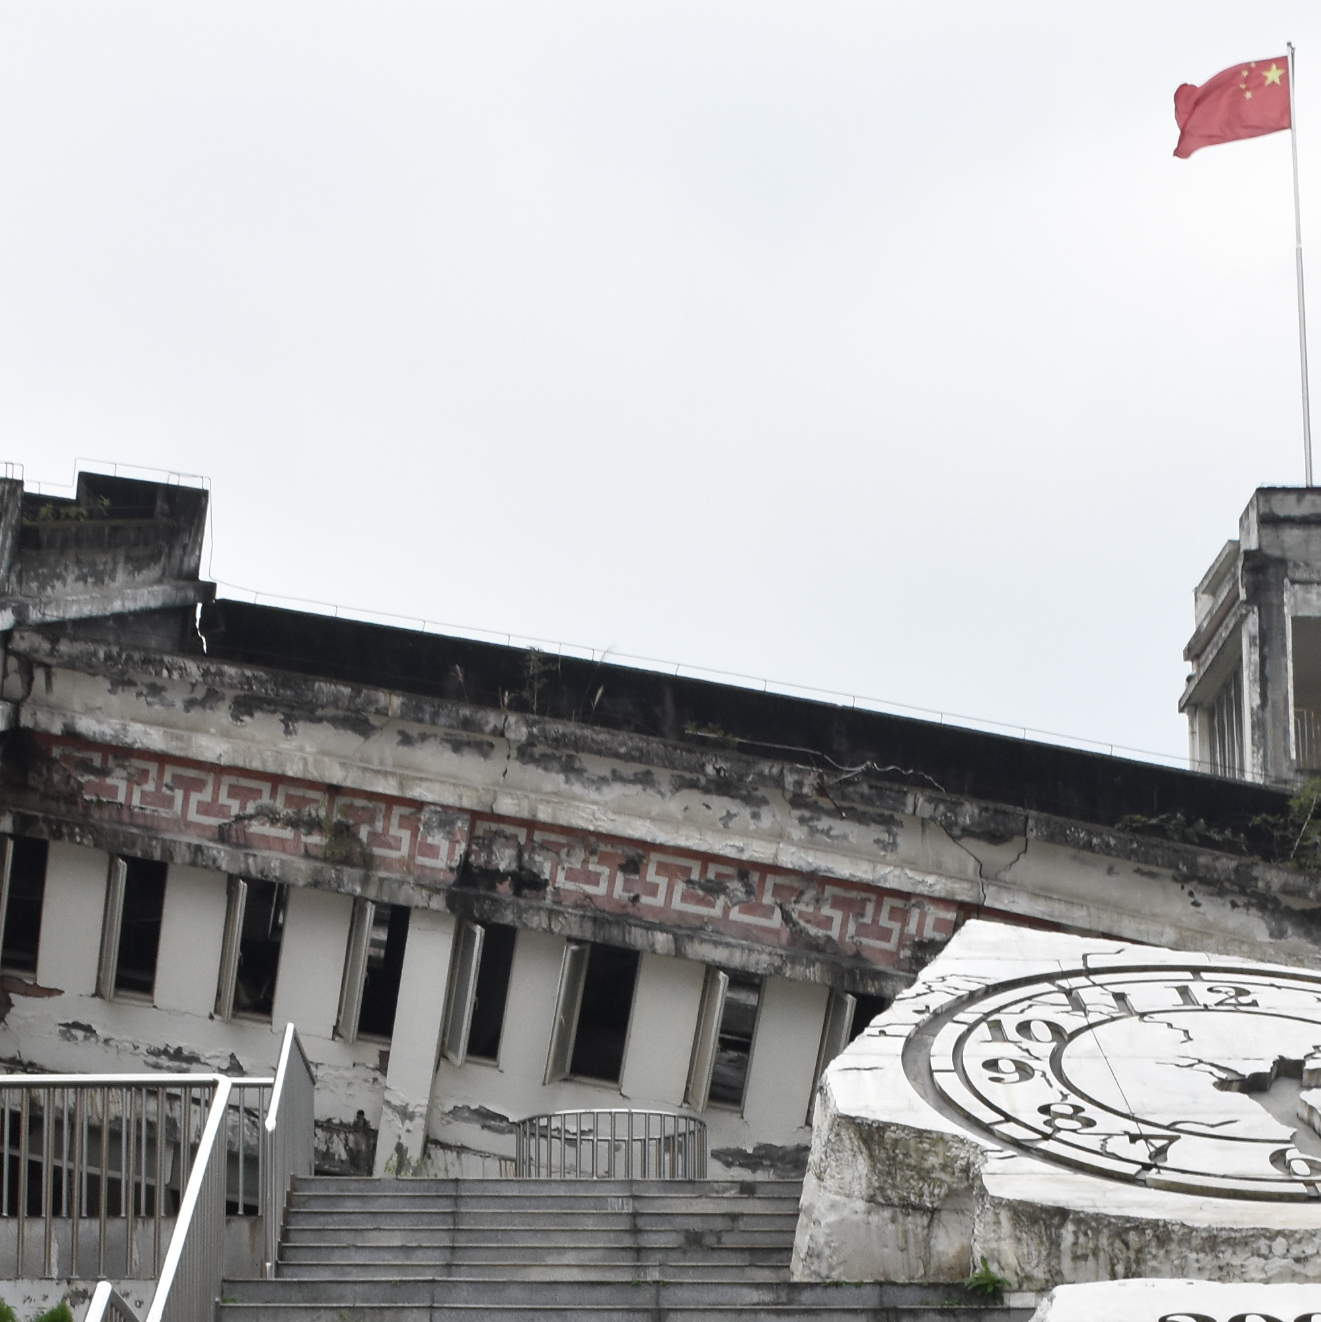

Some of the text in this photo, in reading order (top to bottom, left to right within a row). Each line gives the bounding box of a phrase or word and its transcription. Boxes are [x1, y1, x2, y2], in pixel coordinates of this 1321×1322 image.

[1164, 985, 1259, 1007] 12
[980, 1019, 1068, 1044] 10
[981, 1057, 1035, 1084] 9
[1037, 1102, 1097, 1130] 8
[1124, 1130, 1182, 1163] 7
